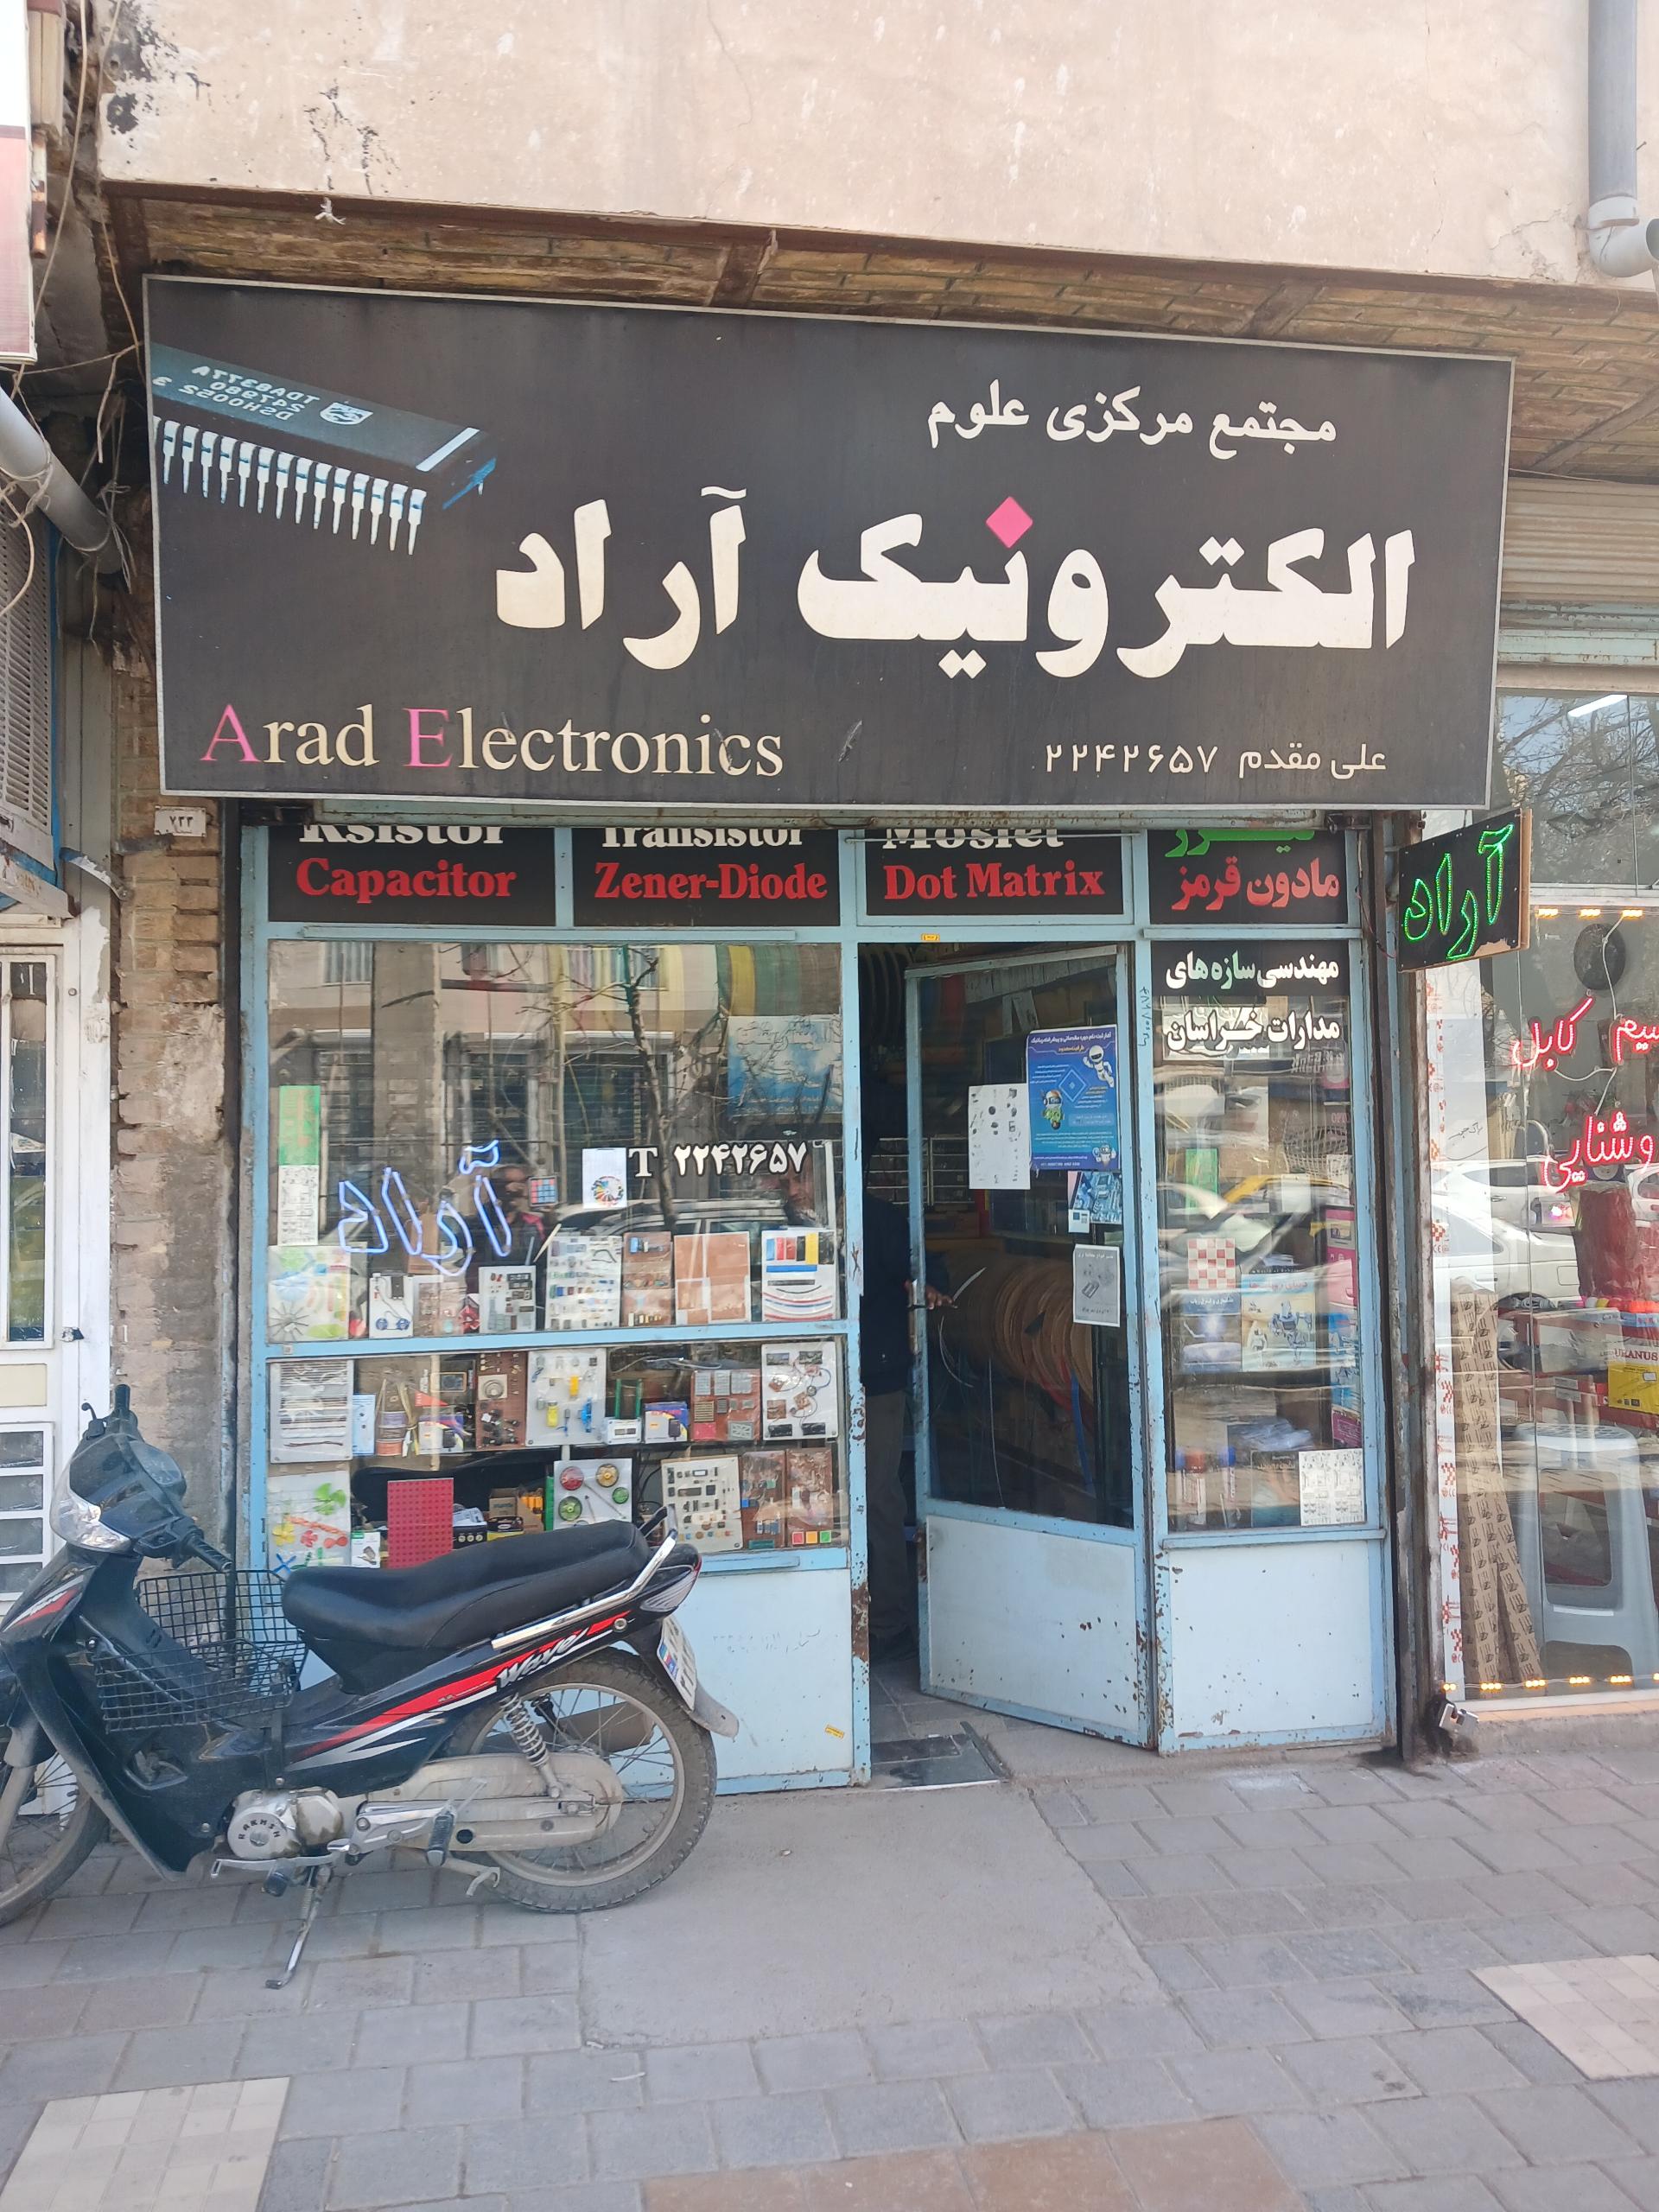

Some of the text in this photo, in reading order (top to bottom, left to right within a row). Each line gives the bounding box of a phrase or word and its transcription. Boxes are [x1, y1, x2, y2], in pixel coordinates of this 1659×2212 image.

[927, 378, 1337, 461] مجتمع مرکزی علوم
[496, 486, 1415, 679] الکترونیک آراد
[200, 703, 784, 778] Arad Electronics
[1046, 741, 1387, 780] علی مقدم ۲۲۴۲۶۵۷
[296, 857, 518, 905] Capacitor
[594, 861, 828, 899] Zener-Diode
[883, 859, 1106, 899] Dot Matrix
[1171, 855, 1339, 911] مادون قرمز
[1403, 822, 1516, 961] آراد
[1256, 953, 1340, 988] مهندسی
[1167, 1007, 1341, 1052] مدارات خراسان
[1512, 995, 1595, 1070] کابل
[628, 1141, 809, 1178] T ۲۲۴۲۶۵۷
[1543, 1110, 1654, 1193] وشنایی
[338, 1139, 512, 1276] آراد
